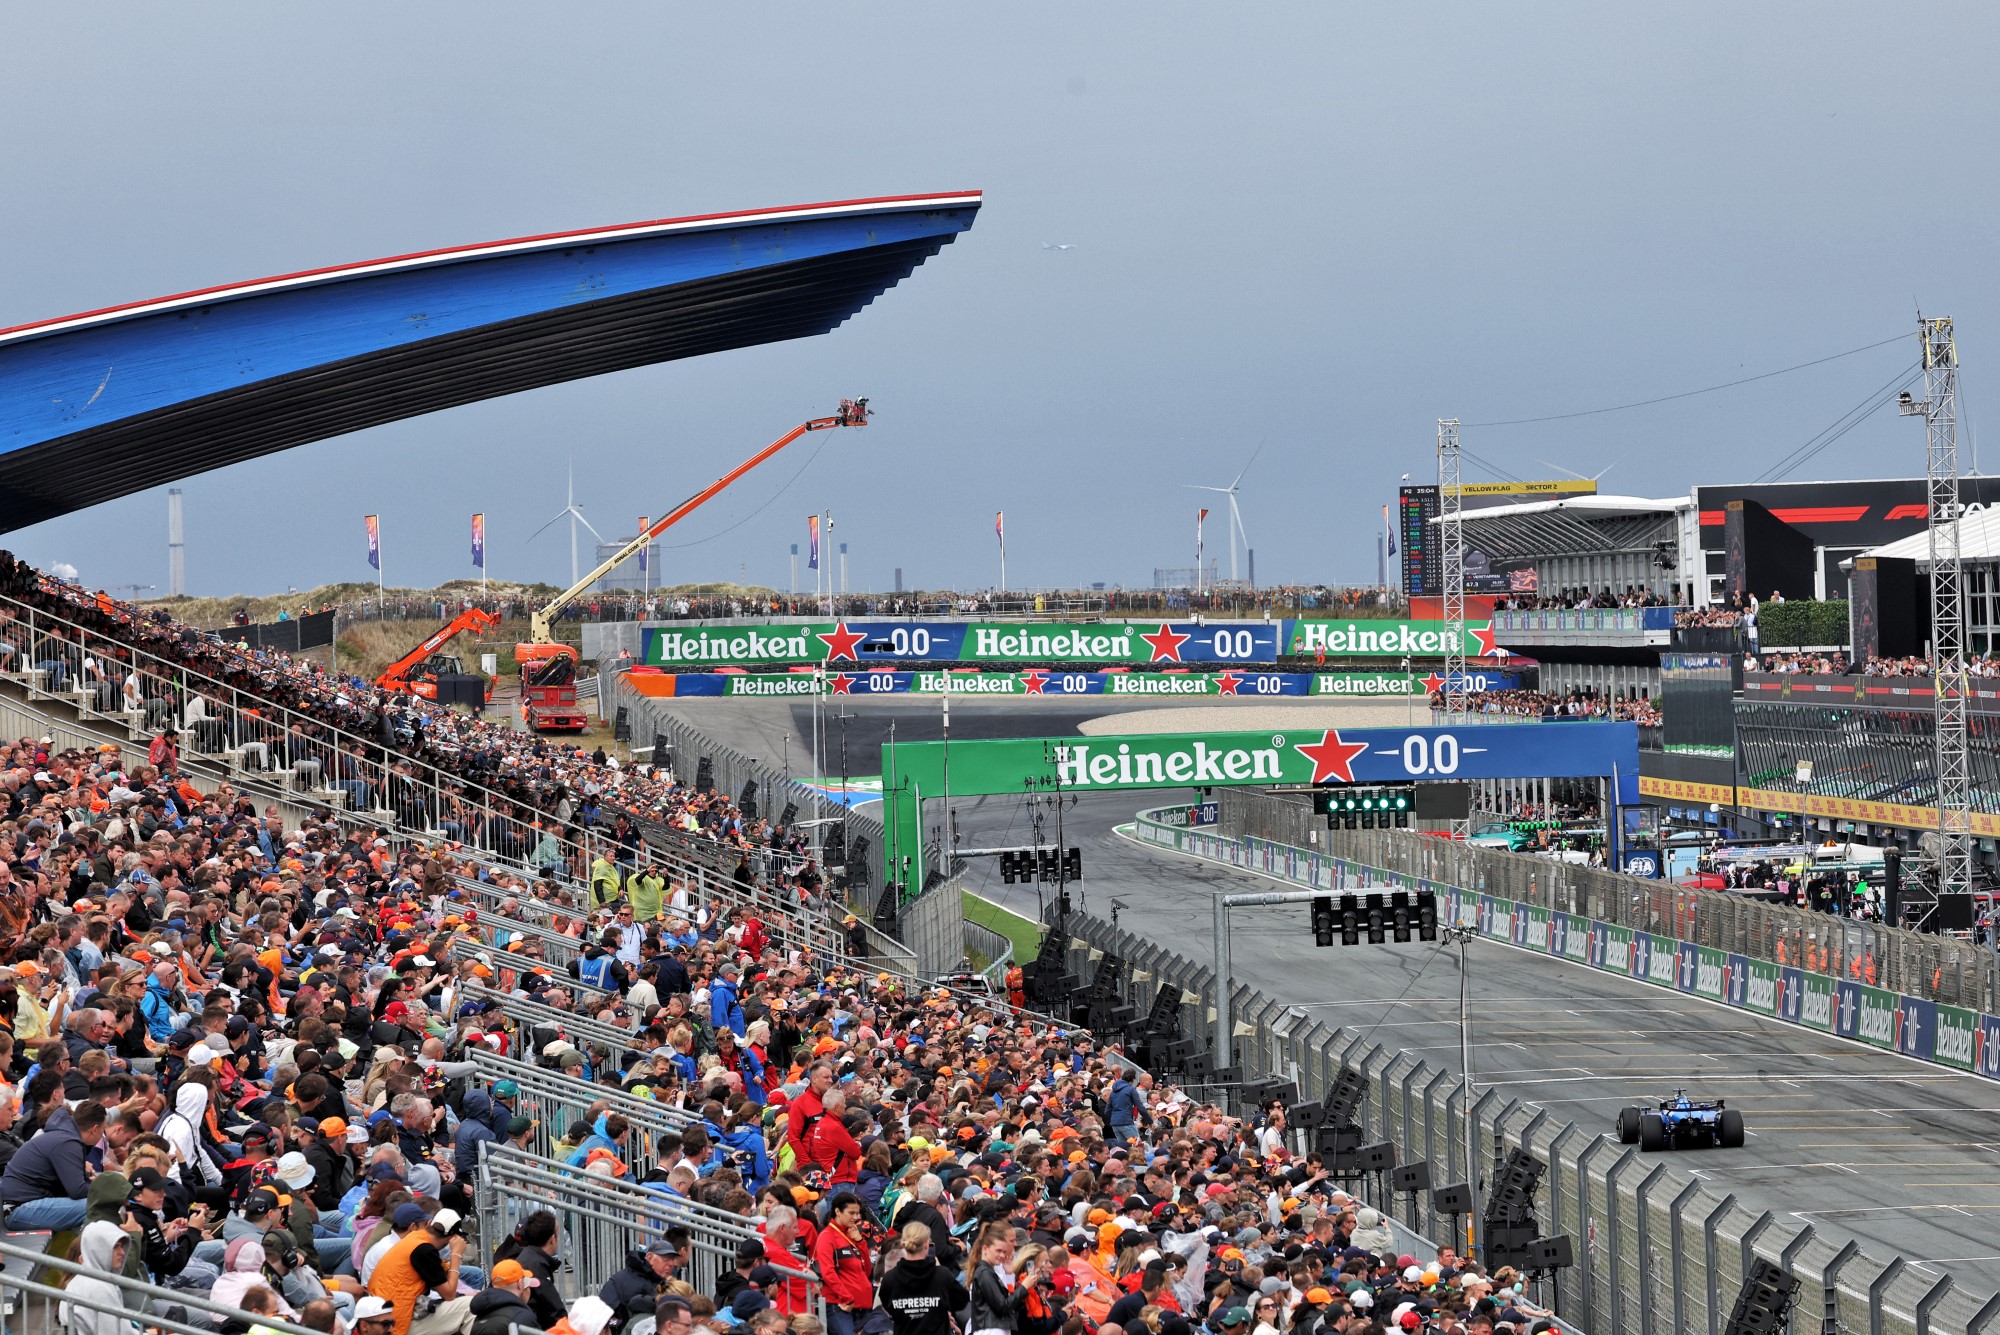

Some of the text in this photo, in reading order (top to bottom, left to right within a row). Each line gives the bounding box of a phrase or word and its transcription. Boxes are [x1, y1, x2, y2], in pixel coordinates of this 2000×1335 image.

[660, 627, 929, 660] Heineken 0.0
[976, 627, 1252, 658] Heineken 0.0
[732, 675, 894, 696] Heineken 0.0
[920, 674, 1087, 692] Heineken 0.0
[1113, 674, 1281, 694] Heineken 0.0
[1318, 674, 1412, 693] Heineken
[1058, 734, 1459, 786] Heineken 0.0
[1160, 810, 1186, 825] Heineken
[1204, 806, 1214, 822] 0.0
[1630, 860, 1654, 873] FIA
[1802, 980, 1830, 1025] Heineken
[1859, 994, 1892, 1042] Heineken
[1936, 1012, 1972, 1064] Heineken
[892, 1296, 940, 1309] REPRESENT
